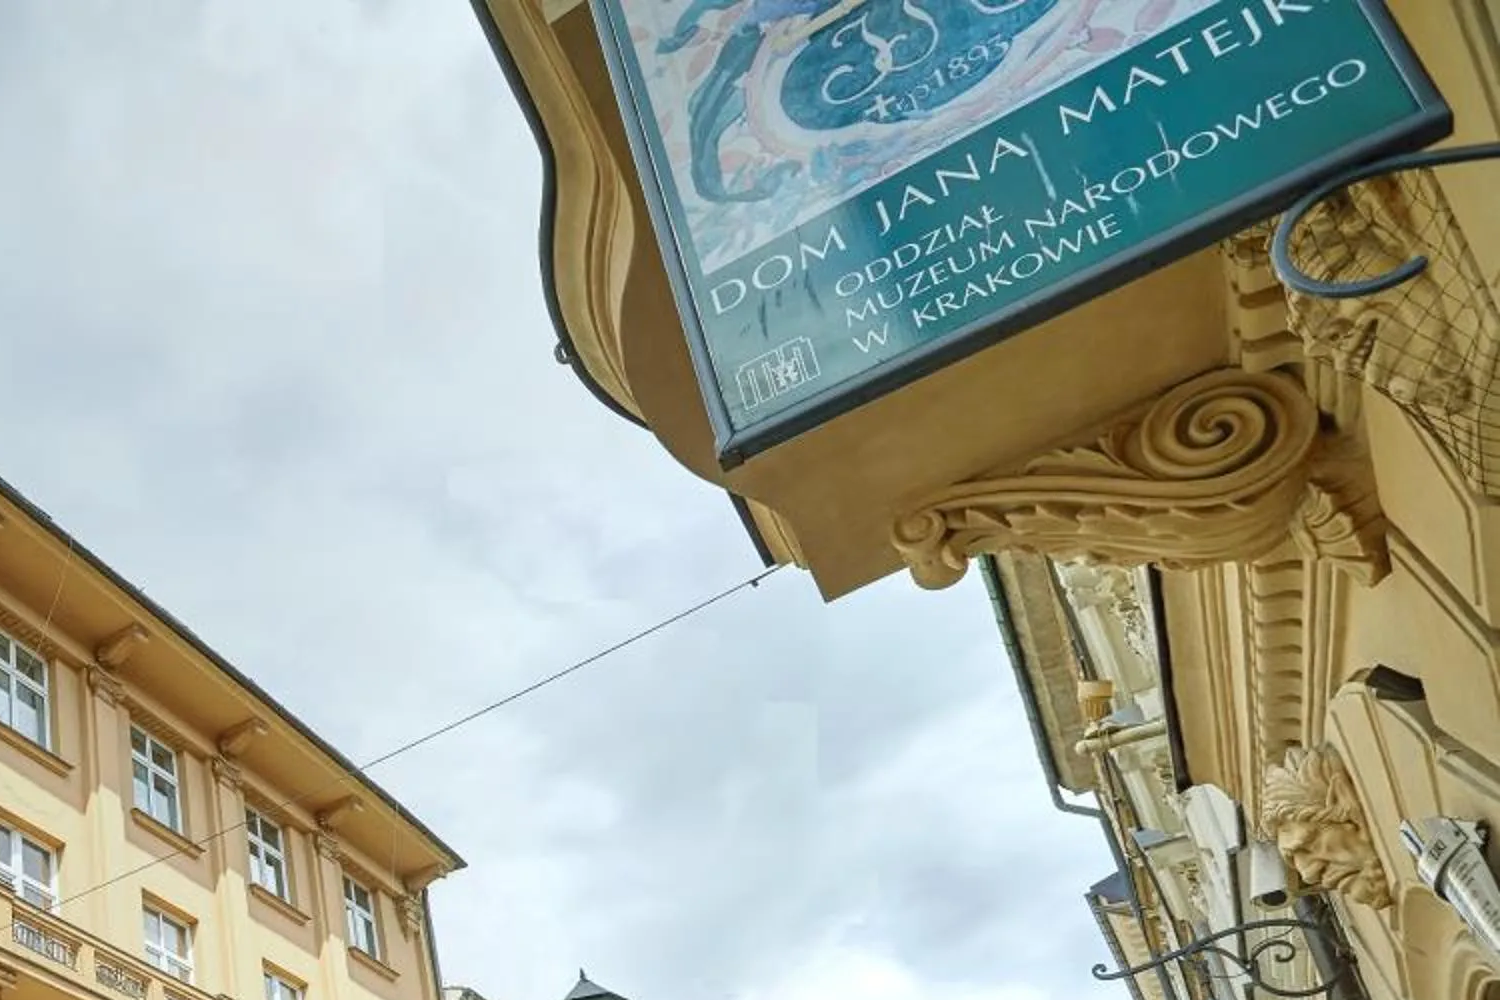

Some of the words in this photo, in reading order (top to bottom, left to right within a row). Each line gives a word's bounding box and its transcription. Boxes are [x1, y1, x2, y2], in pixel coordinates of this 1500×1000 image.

[710, 227, 847, 315] DOM
[875, 136, 1029, 235] JANA
[1058, 0, 1331, 136] MATEJK
[835, 205, 1005, 298] ODDZIAŁ
[846, 233, 1016, 329] MUZEUM
[1025, 58, 1368, 239] NARODOWEGO
[852, 323, 890, 354] W
[912, 213, 1123, 329] KRAKOWIE
